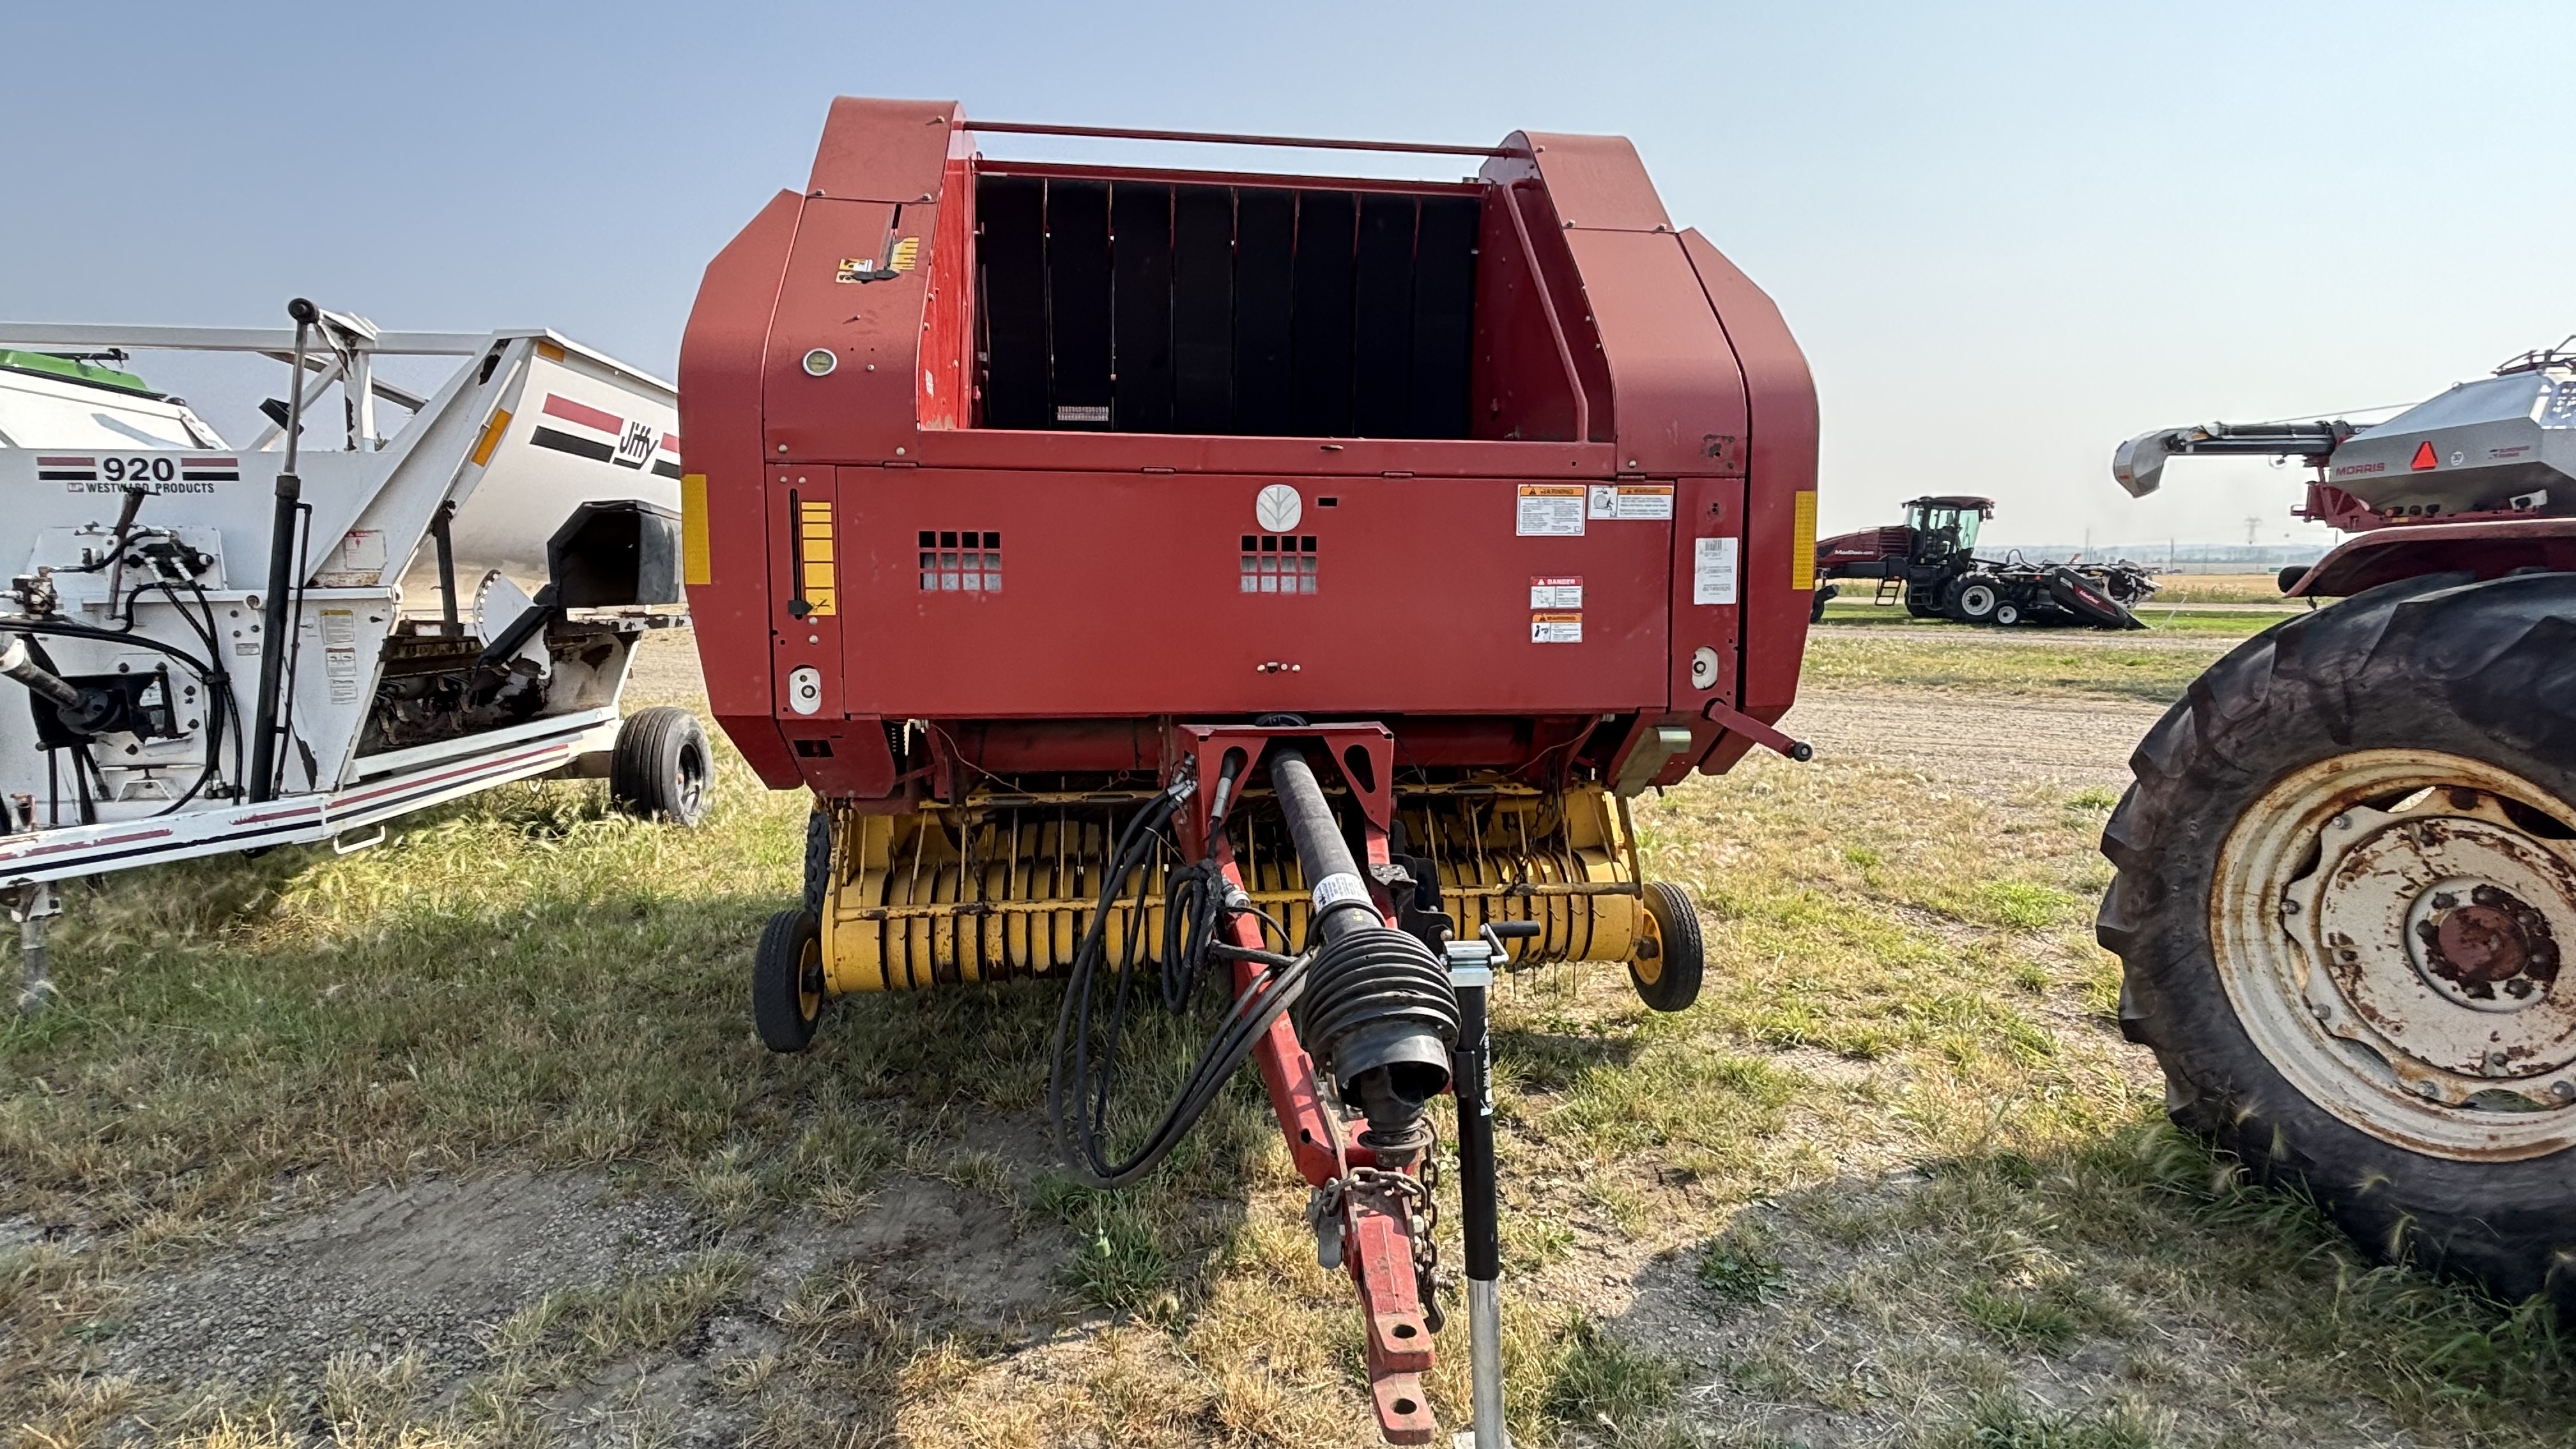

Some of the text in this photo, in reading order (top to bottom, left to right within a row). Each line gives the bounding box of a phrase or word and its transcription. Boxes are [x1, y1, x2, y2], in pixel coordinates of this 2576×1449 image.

[103, 457, 174, 482] 920
[2336, 462, 2385, 477] MORRIS
[155, 482, 215, 493] PRODUCTS
